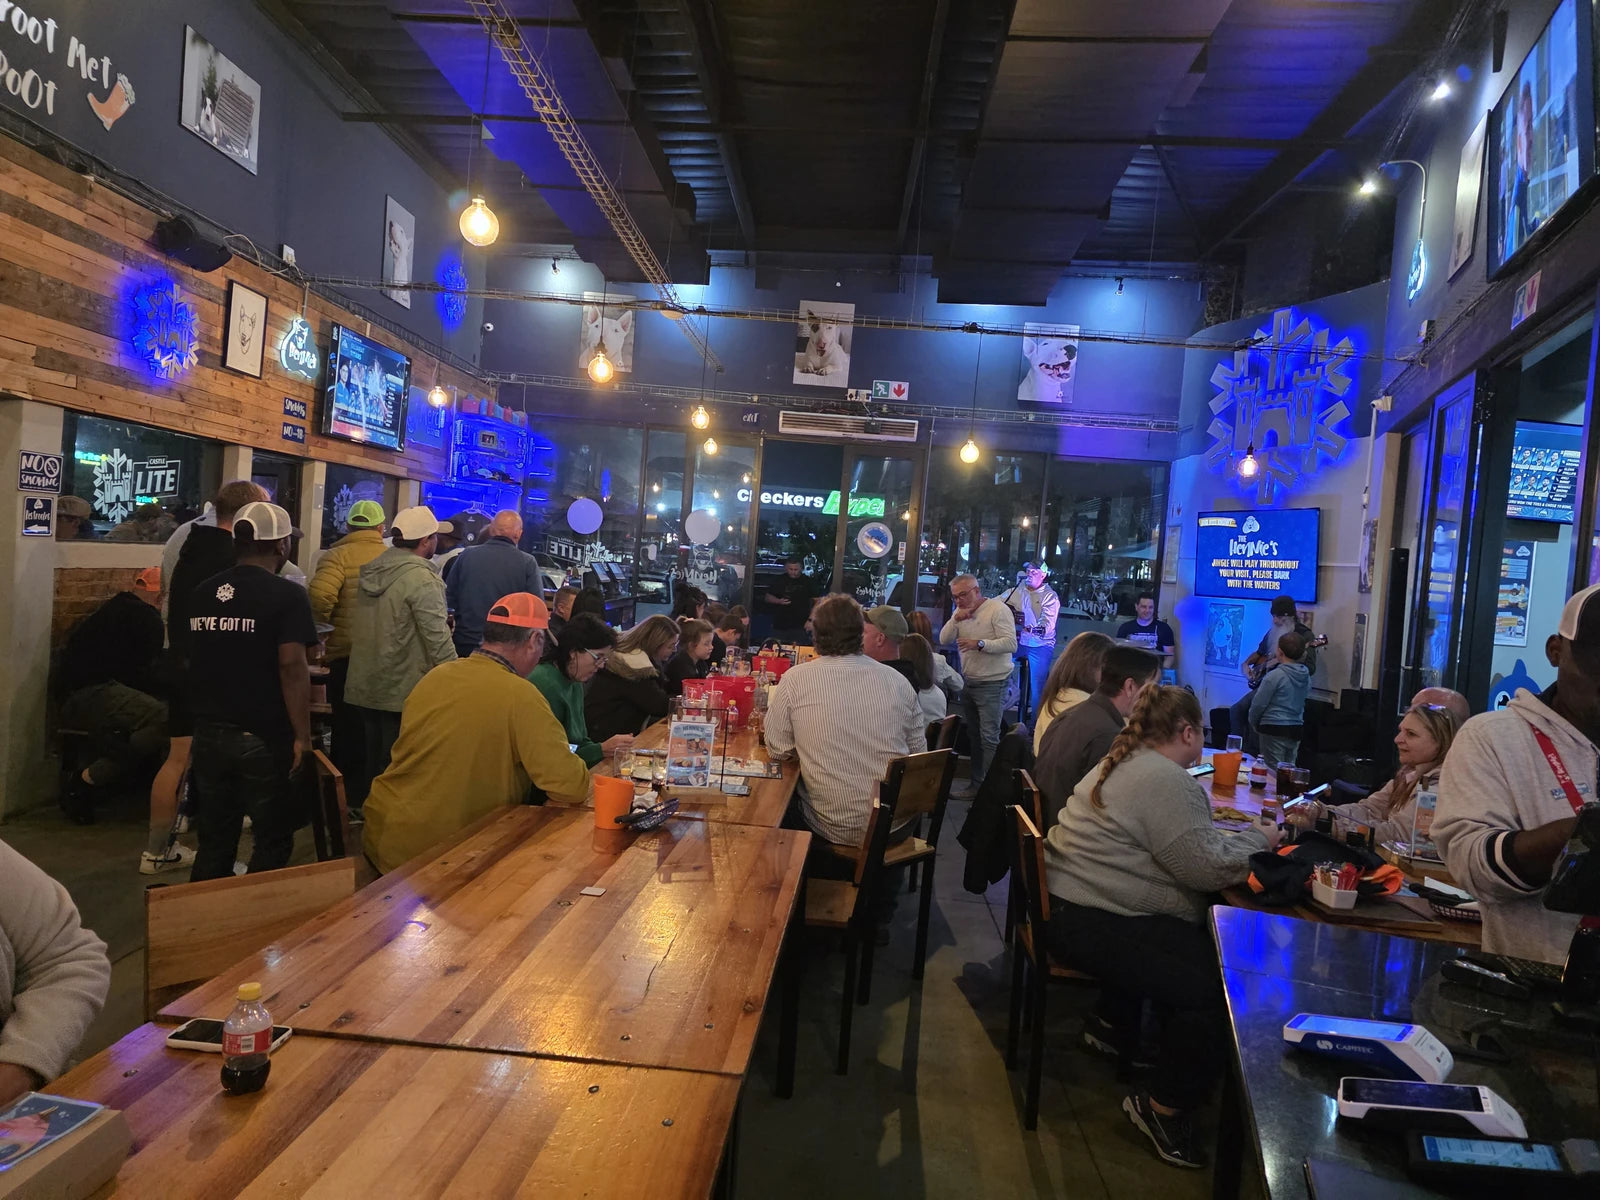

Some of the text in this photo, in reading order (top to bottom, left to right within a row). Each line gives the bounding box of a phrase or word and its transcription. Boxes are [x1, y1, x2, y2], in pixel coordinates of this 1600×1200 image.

[67, 36, 112, 89] Met
[21, 455, 45, 472] NO
[21, 474, 60, 487] SMOKING
[135, 469, 176, 495] LITE
[1230, 559, 1243, 568] WILL
[1244, 560, 1259, 568] PLAY
[1259, 560, 1299, 569] THROUGHOUT
[1219, 569, 1235, 578] YOUR
[1252, 570, 1273, 579] PLEASE
[1273, 571, 1290, 580] BARK
[1227, 579, 1280, 590] WITH THE WAITERS
[190, 617, 255, 633] WE'VE GOT IT!
